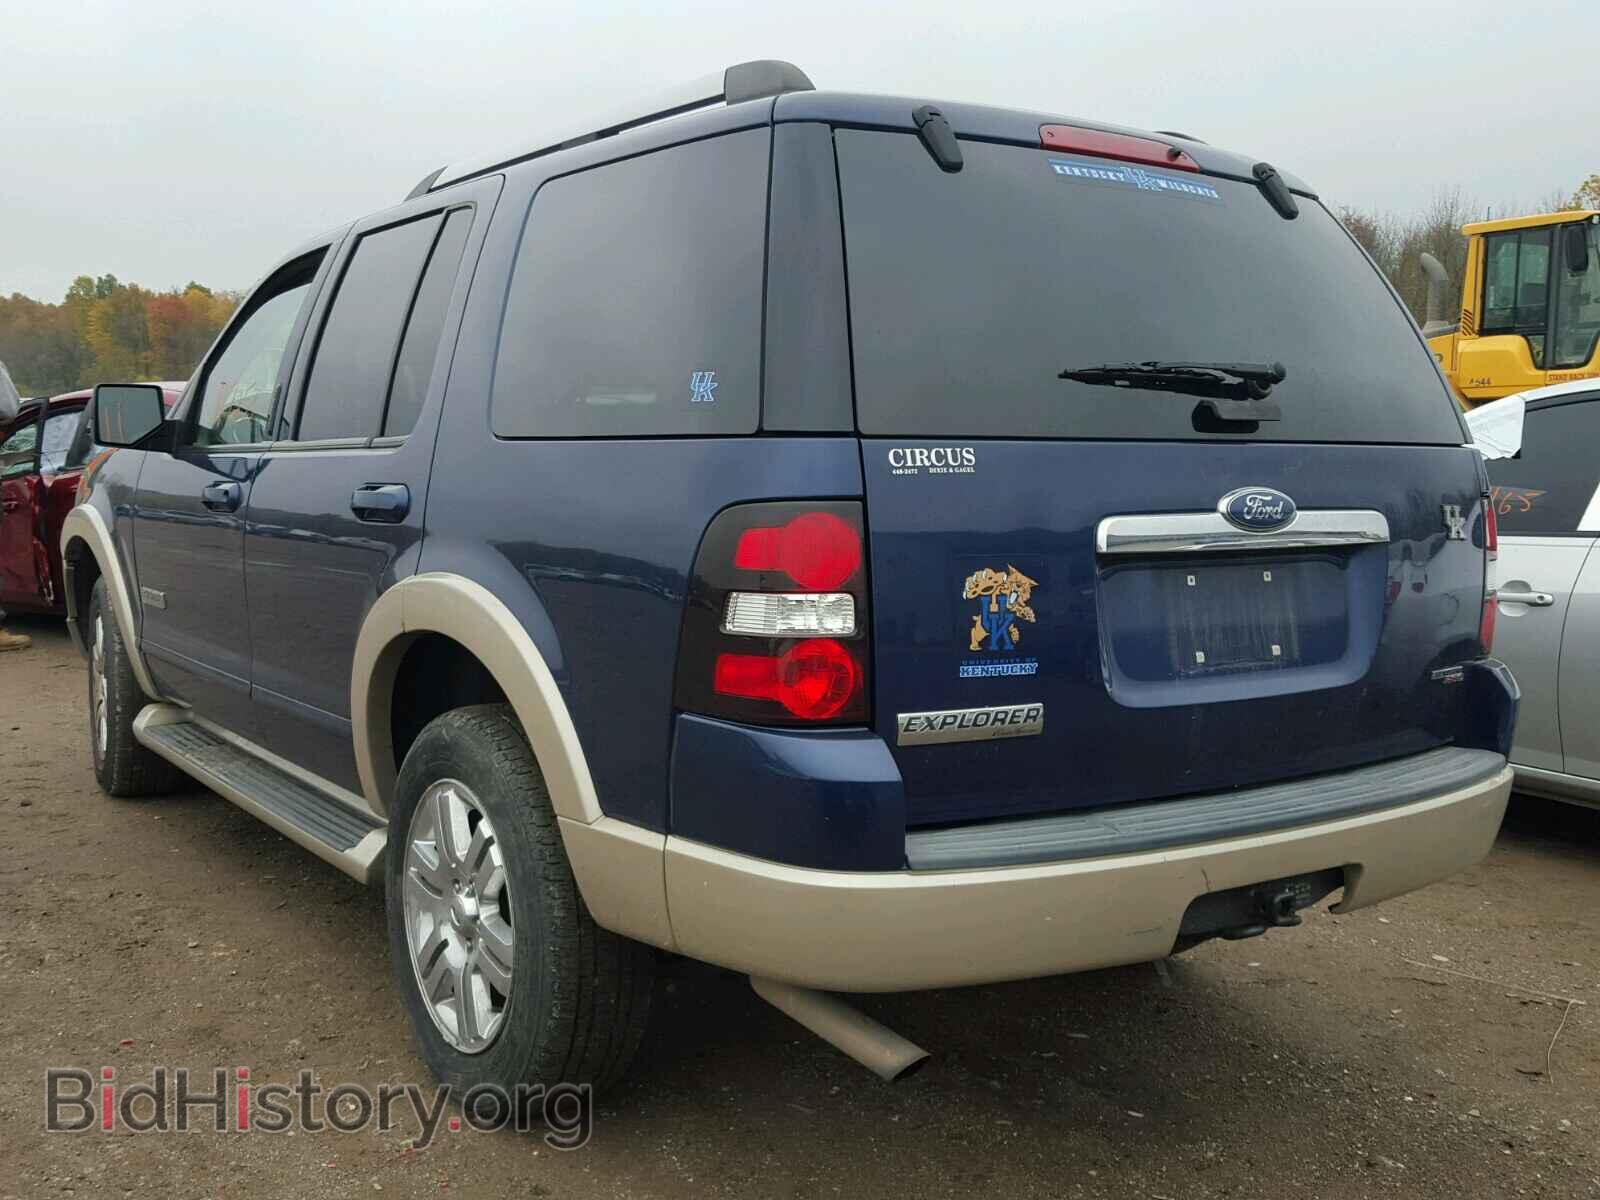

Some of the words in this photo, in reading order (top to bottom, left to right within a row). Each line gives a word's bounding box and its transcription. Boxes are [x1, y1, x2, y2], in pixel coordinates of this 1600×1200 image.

[1053, 164, 1125, 182] KENTUCKY
[888, 447, 976, 467] CIRCUS
[1243, 494, 1284, 520] Ford
[960, 663, 1038, 677] KENTUCKY
[903, 707, 1041, 733] EXPLORER
